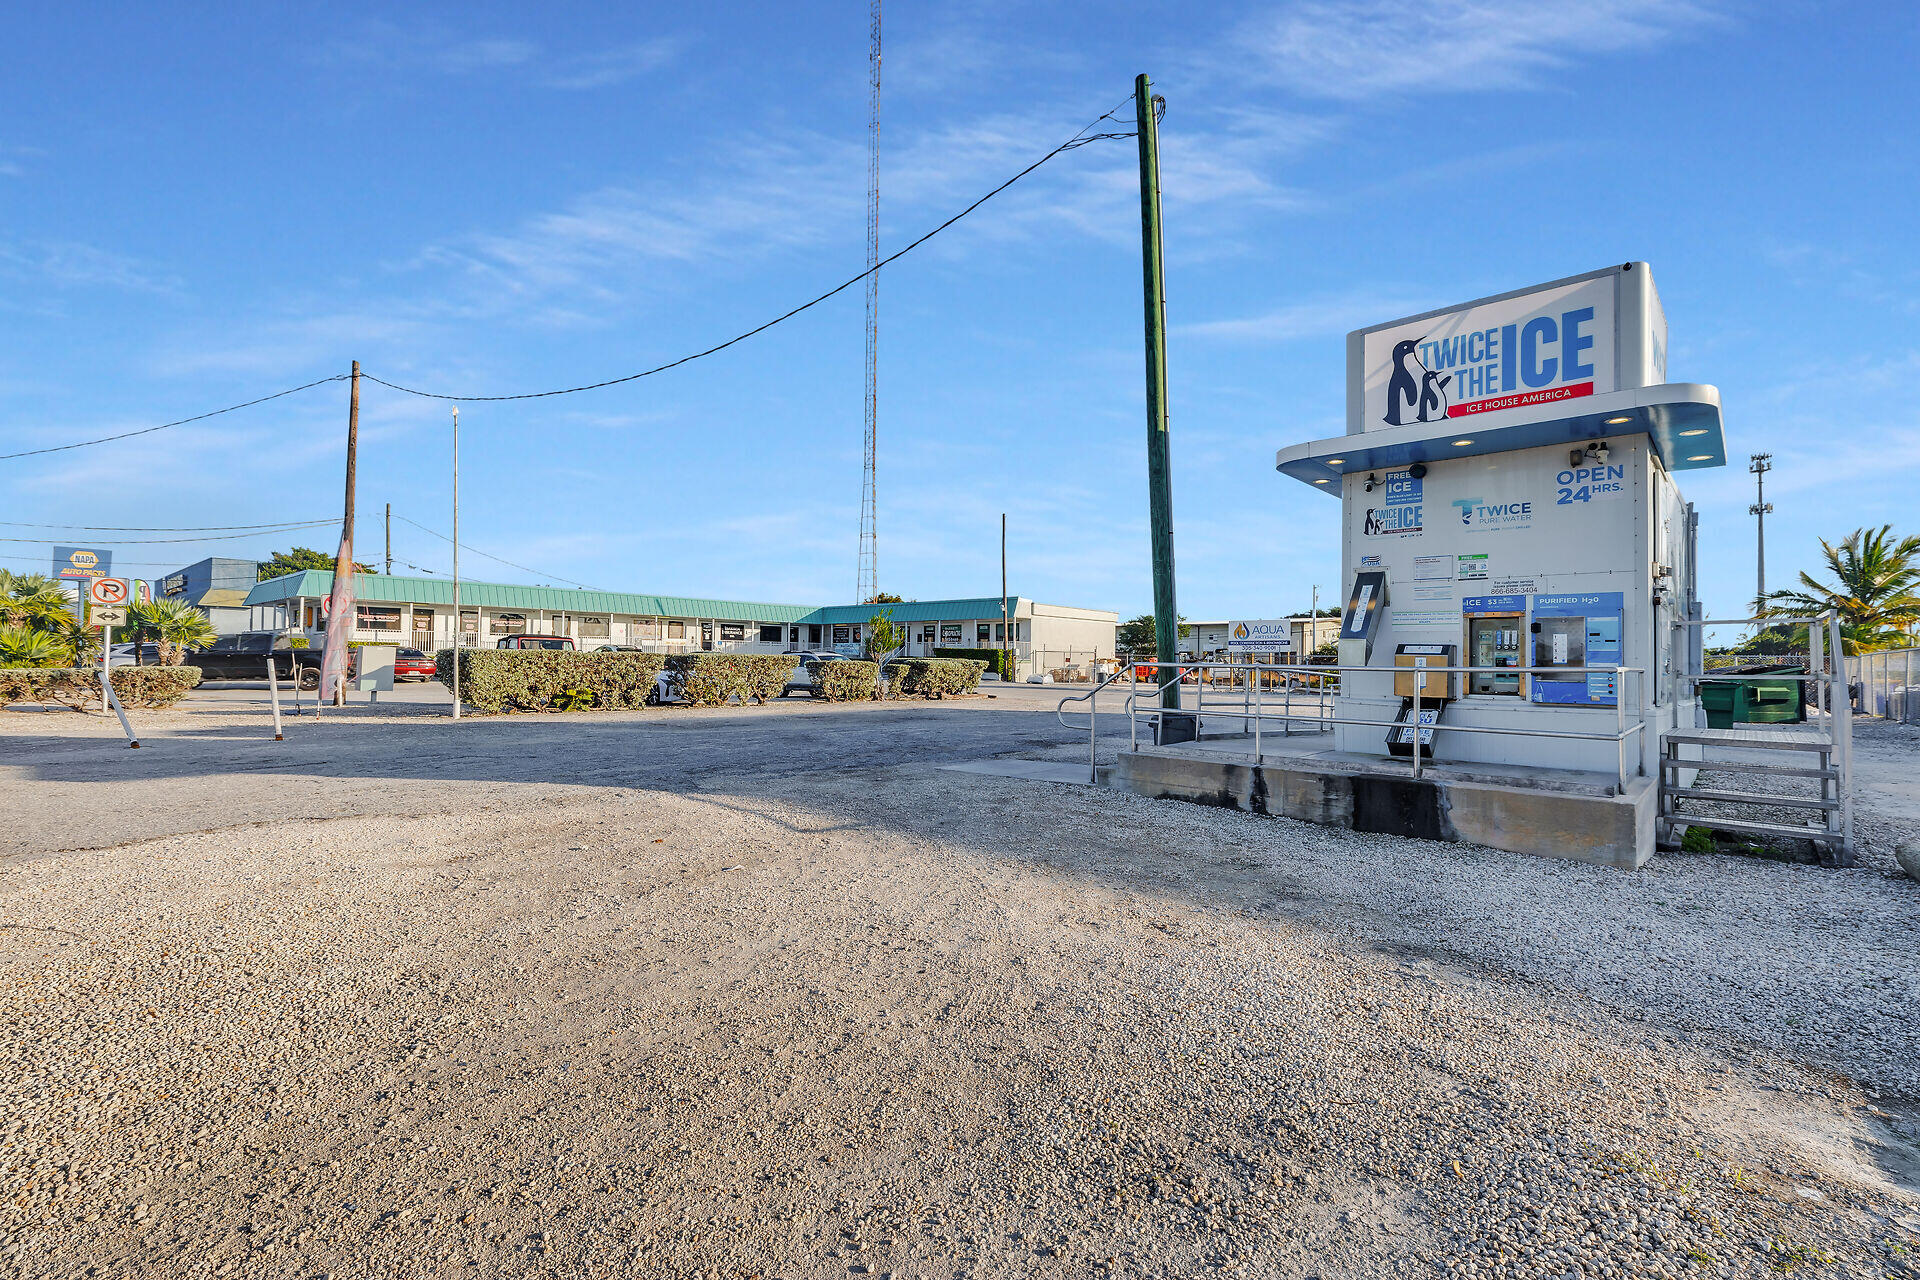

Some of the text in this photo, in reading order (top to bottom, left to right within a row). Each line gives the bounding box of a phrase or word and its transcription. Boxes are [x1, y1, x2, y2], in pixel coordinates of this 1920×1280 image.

[1419, 327, 1499, 371] TWICE
[1501, 305, 1594, 393] ICE
[1454, 363, 1499, 400] THE
[1466, 388, 1572, 413] ICE HOUSE AMERICA
[1387, 471, 1412, 481] FREE
[1556, 464, 1624, 486] OPEN
[1388, 481, 1412, 493] ICE
[1556, 482, 1624, 505] 24 HRS.
[1374, 508, 1397, 520] TWICE
[1397, 505, 1423, 529] ICE
[1476, 502, 1532, 518] TWICE
[1384, 519, 1397, 530] THE
[1502, 514, 1532, 523] WATER
[75, 555, 95, 564] NAPA
[1251, 624, 1285, 635] AQUA
